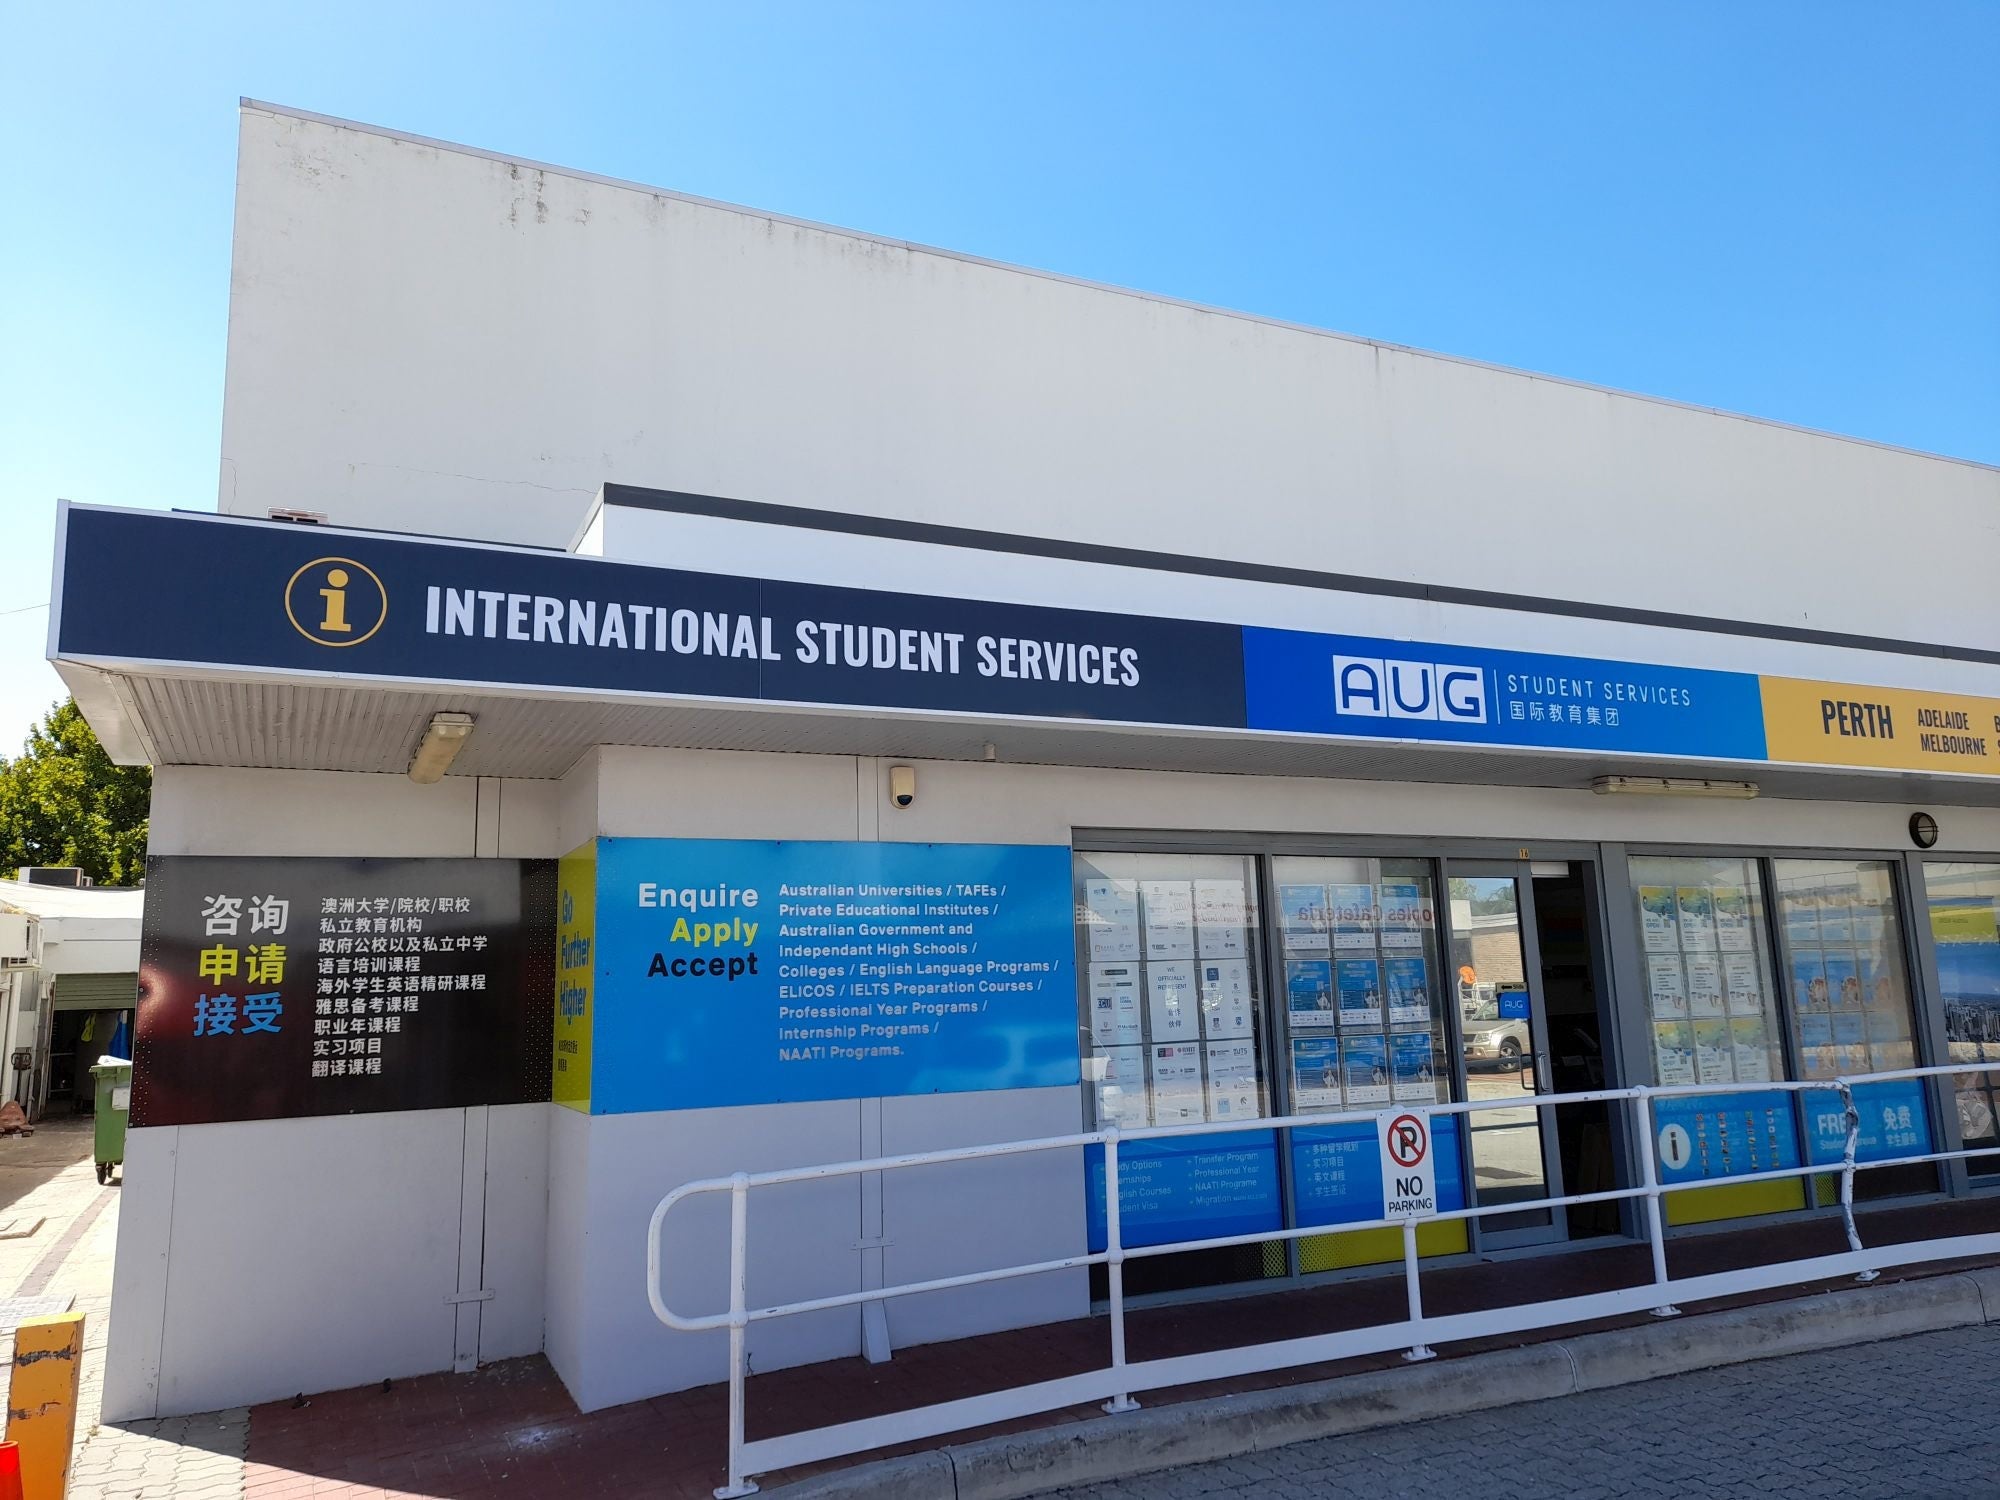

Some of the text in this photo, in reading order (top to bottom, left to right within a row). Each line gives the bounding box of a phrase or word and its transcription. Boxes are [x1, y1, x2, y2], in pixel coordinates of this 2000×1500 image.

[425, 586, 1140, 687] INTERNATIONAL STUDENT SERVICES
[1341, 663, 1481, 717] AUG
[1508, 674, 1690, 706] STUDENT SERVICES
[1509, 701, 1619, 726] 国际教育集团
[1821, 700, 1894, 739] PERTH
[1918, 709, 1969, 730] ADELAIDE
[1921, 734, 1987, 756] MELBOURNE
[638, 883, 759, 913] Enquire
[779, 884, 854, 897] Australian
[859, 884, 942, 897] Universities
[956, 885, 997, 897] TAFEs
[201, 895, 289, 936] 咨询
[321, 897, 471, 914] 澳洲大学/院校/职校
[563, 889, 573, 925] Go
[779, 904, 831, 917] Private
[836, 903, 920, 916] Educational
[924, 903, 989, 915] Institutes
[320, 917, 422, 933] 私立教育机构
[670, 917, 759, 947] Apply
[779, 923, 972, 937] Australian Government and
[318, 936, 488, 953] 政府公校以及私立中学
[561, 932, 590, 969] Further
[779, 943, 872, 959] Independant
[877, 943, 909, 957] High
[914, 942, 967, 955] Schools
[200, 943, 287, 985] 申请
[318, 957, 421, 974] 语言培训课程
[648, 952, 758, 981] Accept
[779, 963, 844, 980] Colleges
[860, 962, 912, 978] English
[916, 962, 983, 977] Language
[987, 960, 1050, 974] Programs
[317, 974, 487, 994] 海外学生英语精研课程
[779, 984, 835, 999] ELICOS
[850, 983, 889, 996] IELTS
[894, 981, 975, 995] Preparation
[979, 980, 1033, 992] Courses
[315, 996, 419, 1015] 雅思备考课程
[560, 978, 587, 1025] Higher
[779, 1004, 872, 1018] Professional
[877, 1003, 907, 1016] Year
[912, 1001, 978, 1017] Programs
[1505, 1000, 1523, 1008] AUG
[193, 992, 283, 1037] 接受
[314, 1017, 401, 1035] 职业年课程
[779, 1025, 856, 1042] Internship
[861, 1023, 929, 1039] Programs
[313, 1038, 382, 1056] 实习项目
[779, 1044, 904, 1062] NAATI Programs.
[312, 1058, 382, 1077] 翻译课程
[1396, 1176, 1423, 1197] NO
[1389, 1198, 1432, 1212] PARKING
